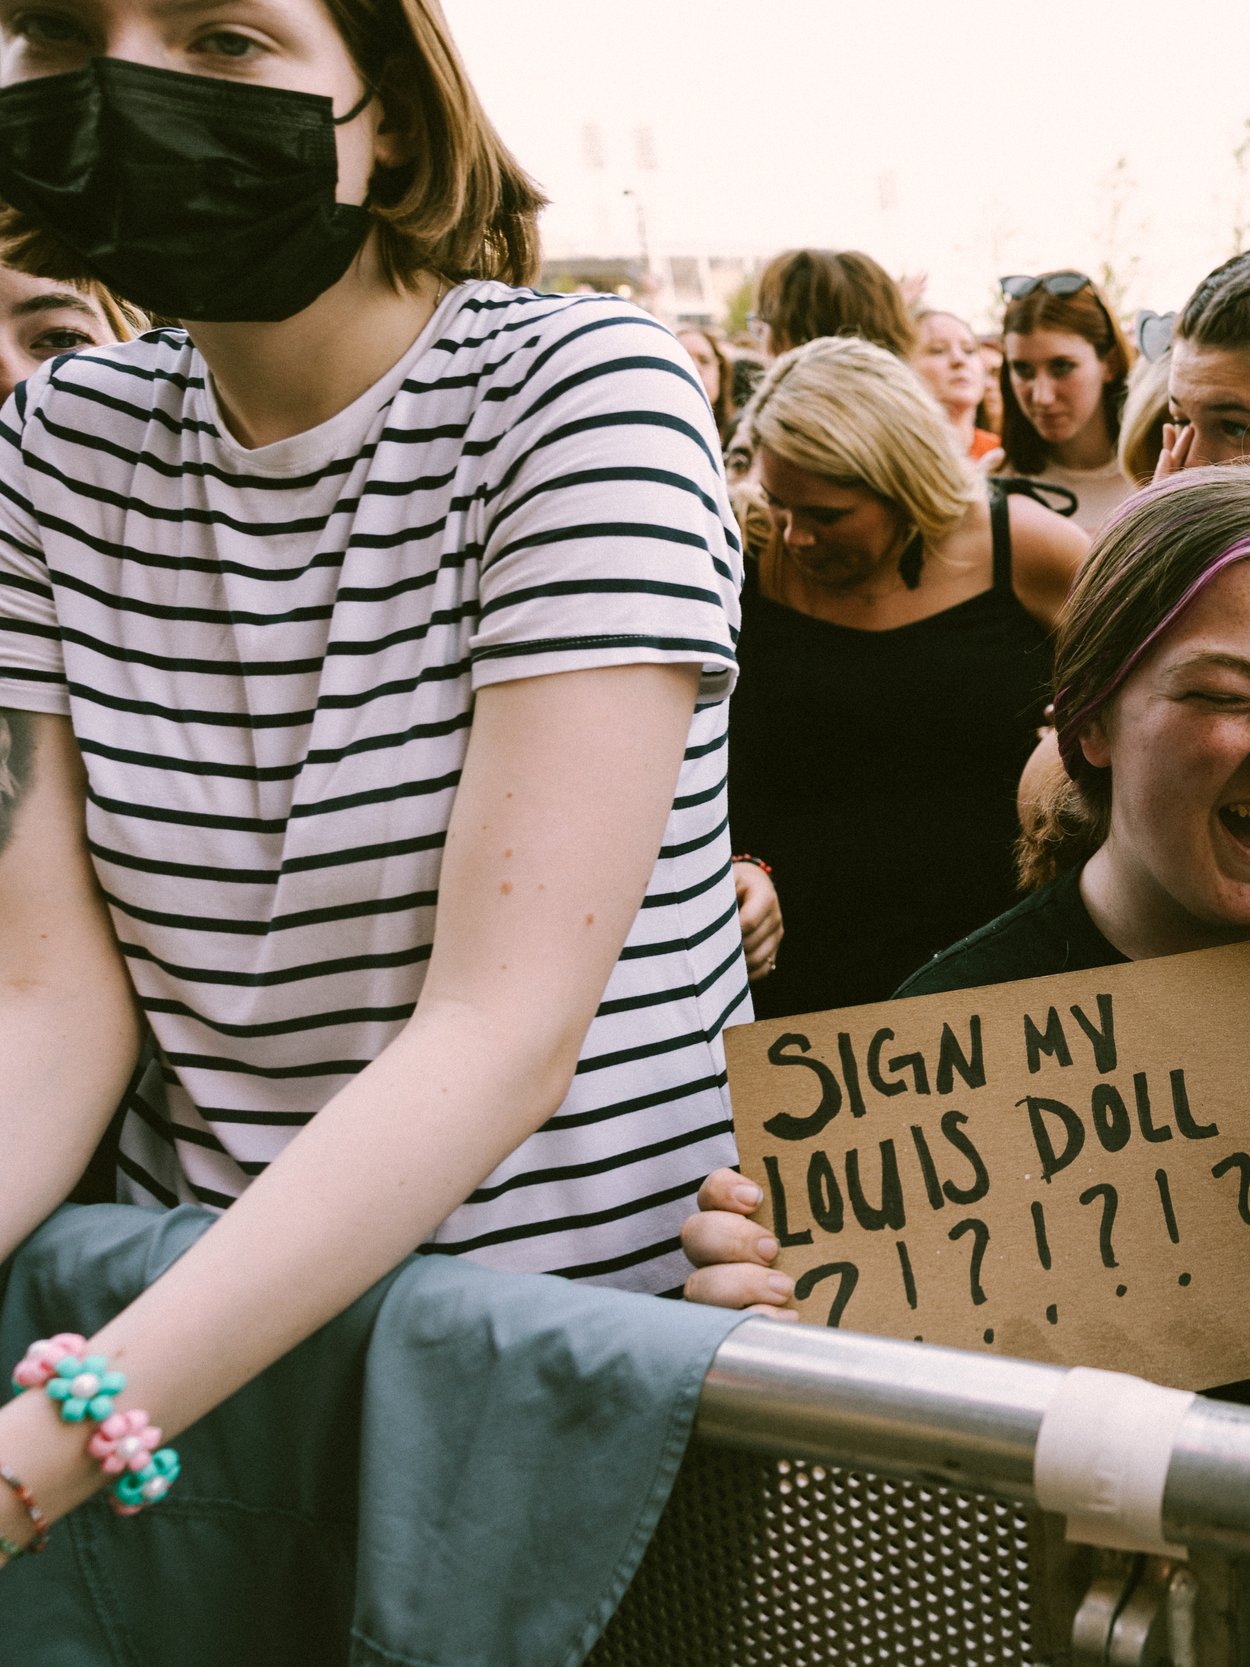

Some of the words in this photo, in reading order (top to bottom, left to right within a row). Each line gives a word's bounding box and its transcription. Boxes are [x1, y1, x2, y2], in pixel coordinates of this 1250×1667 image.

[763, 1014, 987, 1141] SIGN
[1023, 993, 1118, 1075] MY
[762, 1110, 991, 1248] LOUIS
[1014, 1069, 1219, 1184] DOLL
